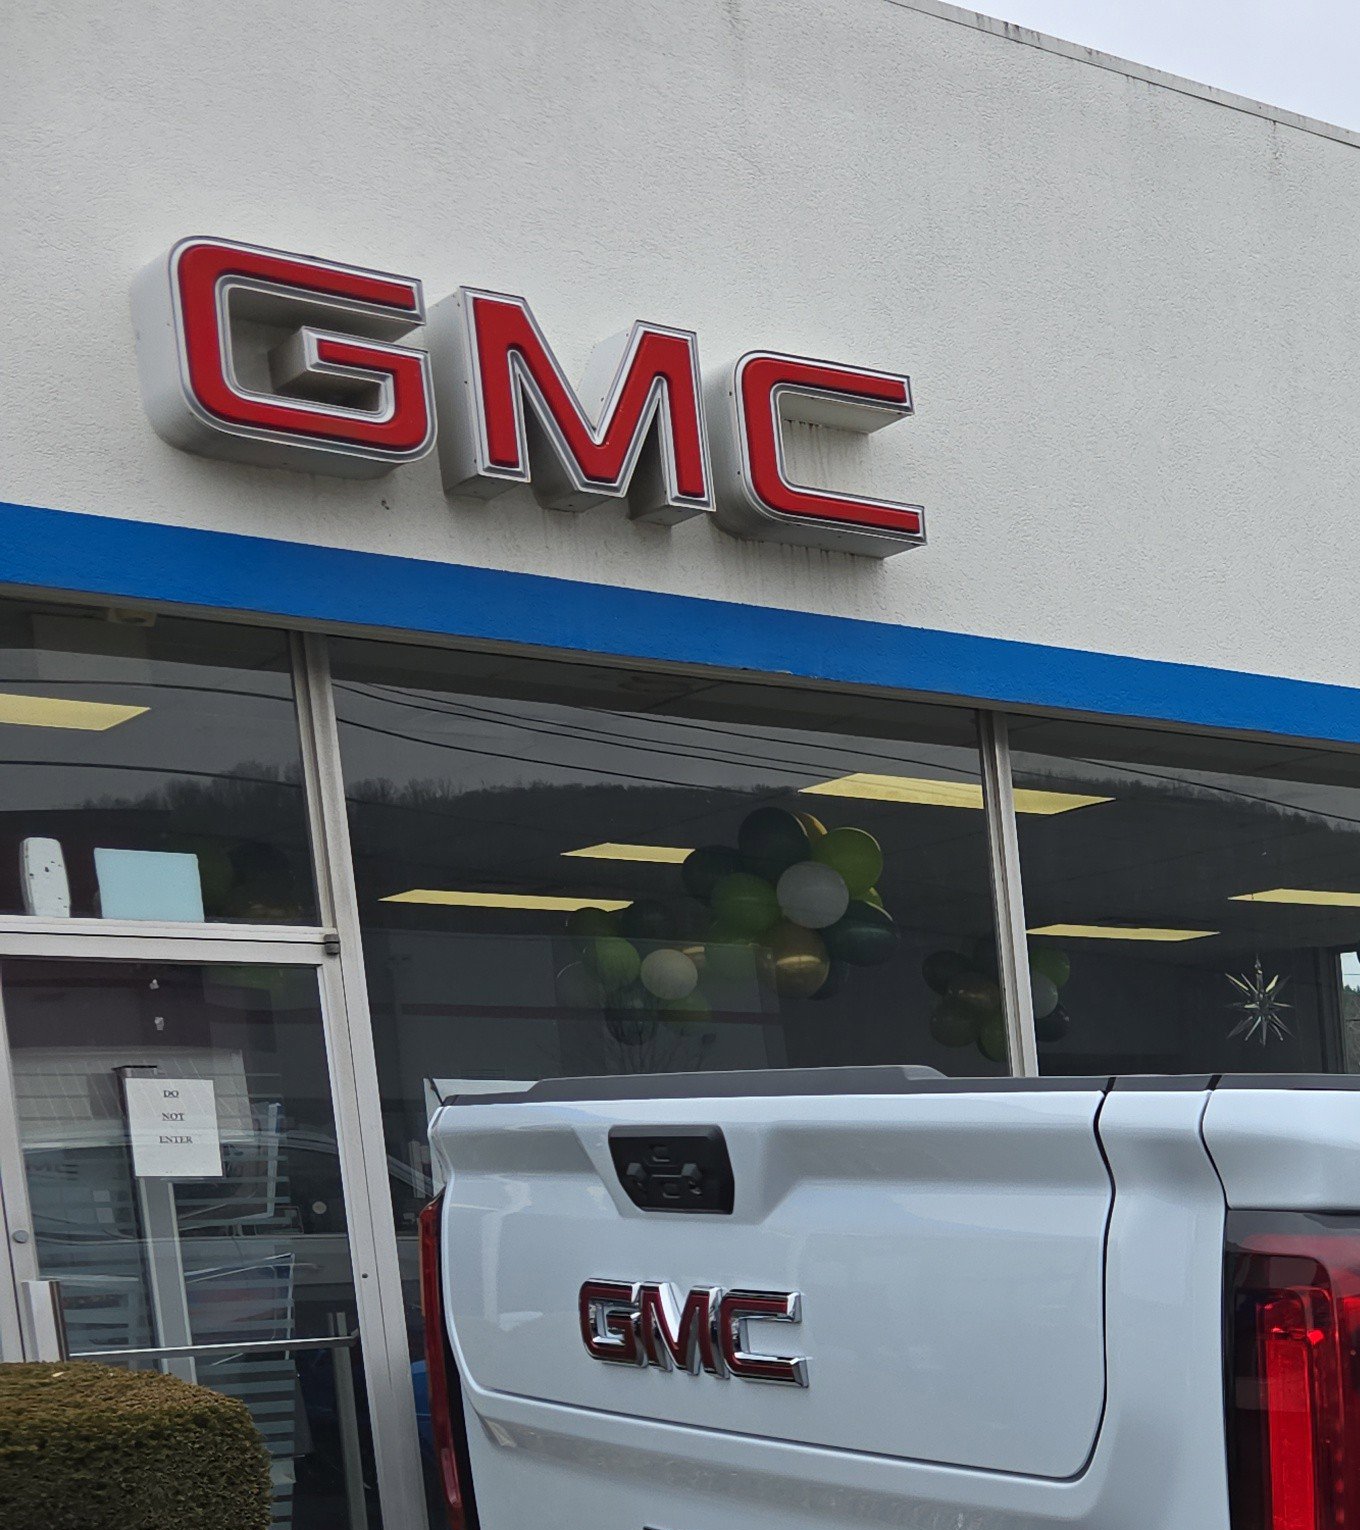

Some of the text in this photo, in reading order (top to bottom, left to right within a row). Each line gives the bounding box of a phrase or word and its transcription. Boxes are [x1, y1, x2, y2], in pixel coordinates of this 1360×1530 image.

[134, 235, 927, 557] GMC
[163, 1090, 179, 1098] DO
[162, 1112, 185, 1121] NOT
[159, 1136, 193, 1144] ENTER
[579, 1278, 809, 1388] GMC
